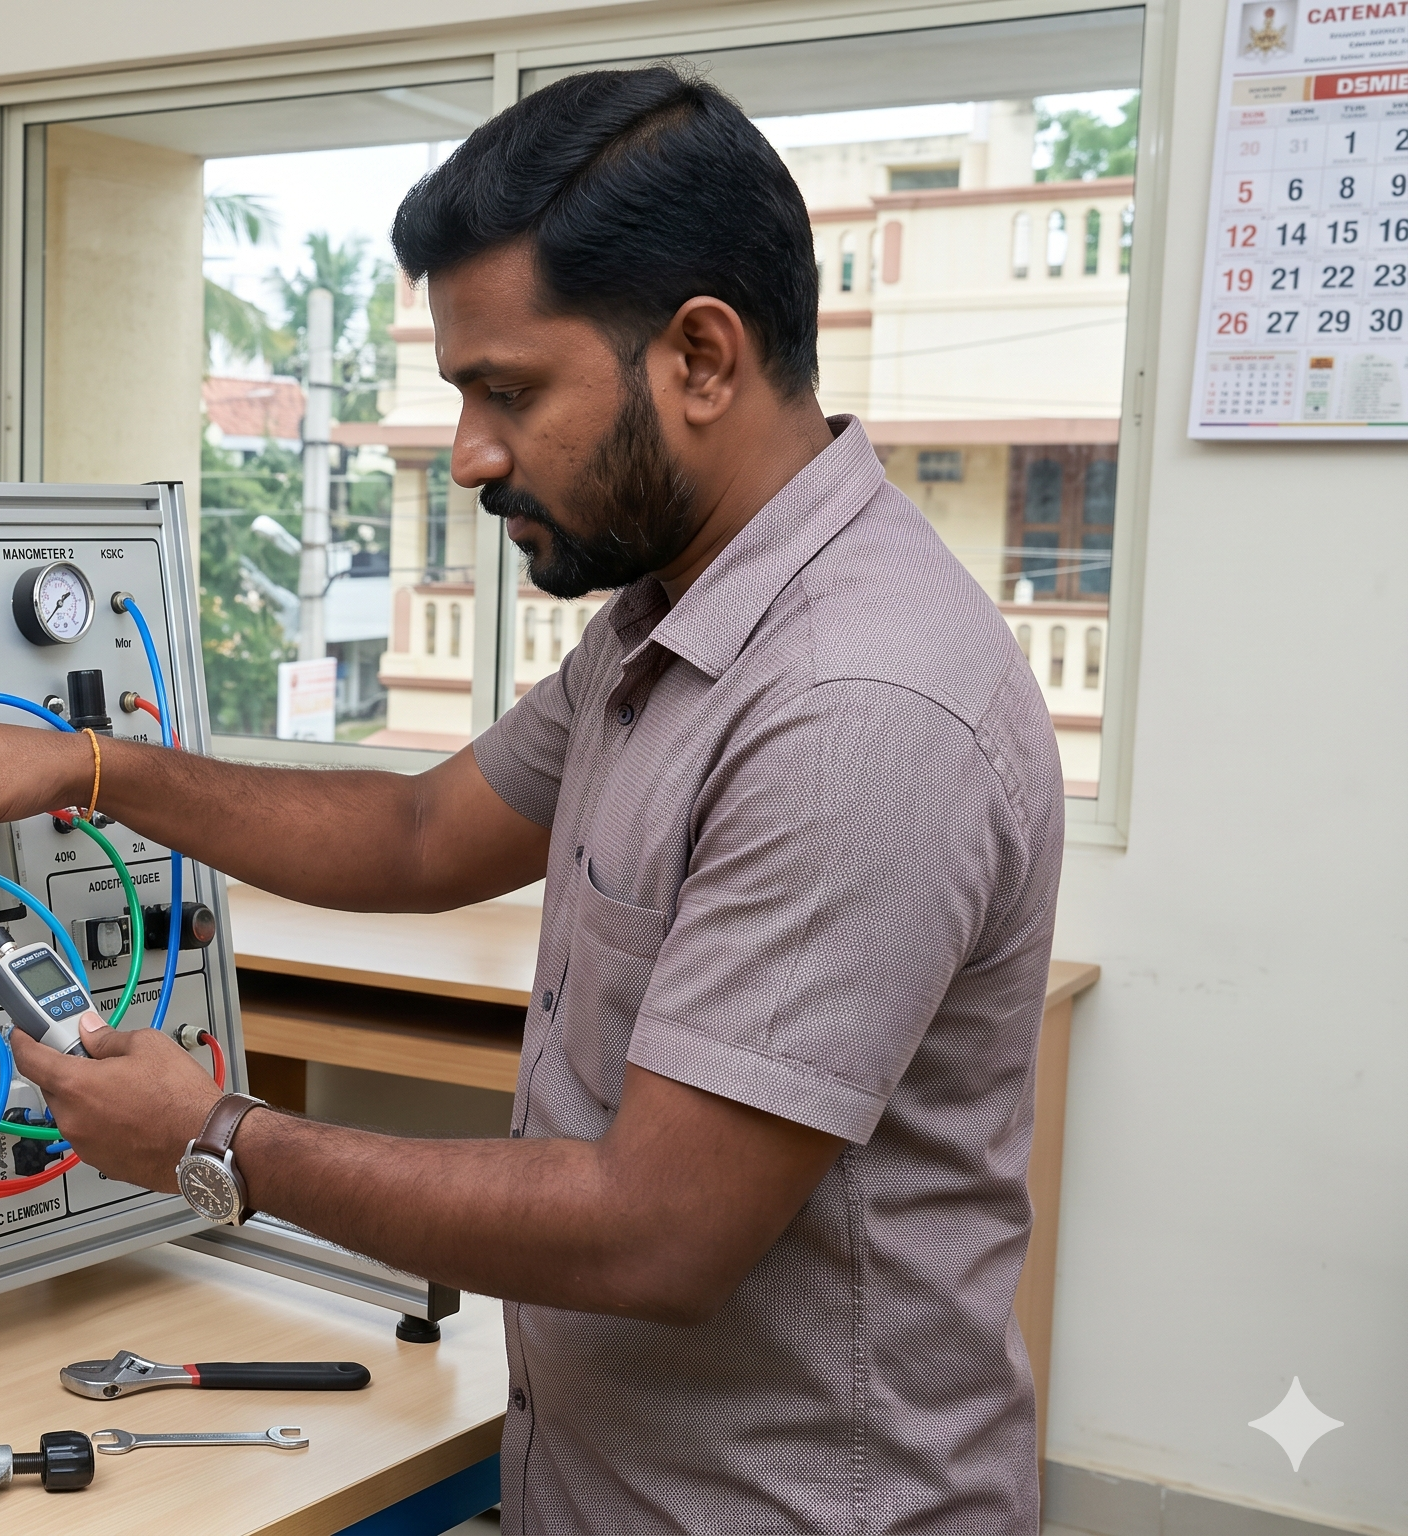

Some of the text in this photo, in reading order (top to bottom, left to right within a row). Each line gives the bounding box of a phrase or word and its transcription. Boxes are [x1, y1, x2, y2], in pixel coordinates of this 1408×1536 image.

[1344, 130, 1356, 154] 1
[1395, 128, 1408, 152] 2
[1237, 174, 1407, 204] 5 6 8 9
[1226, 218, 1408, 248] 12 14 15 16
[1223, 263, 1407, 292] 19 21 22 23
[1217, 308, 1403, 335] 26 27 29 30
[66, 548, 74, 559] 2
